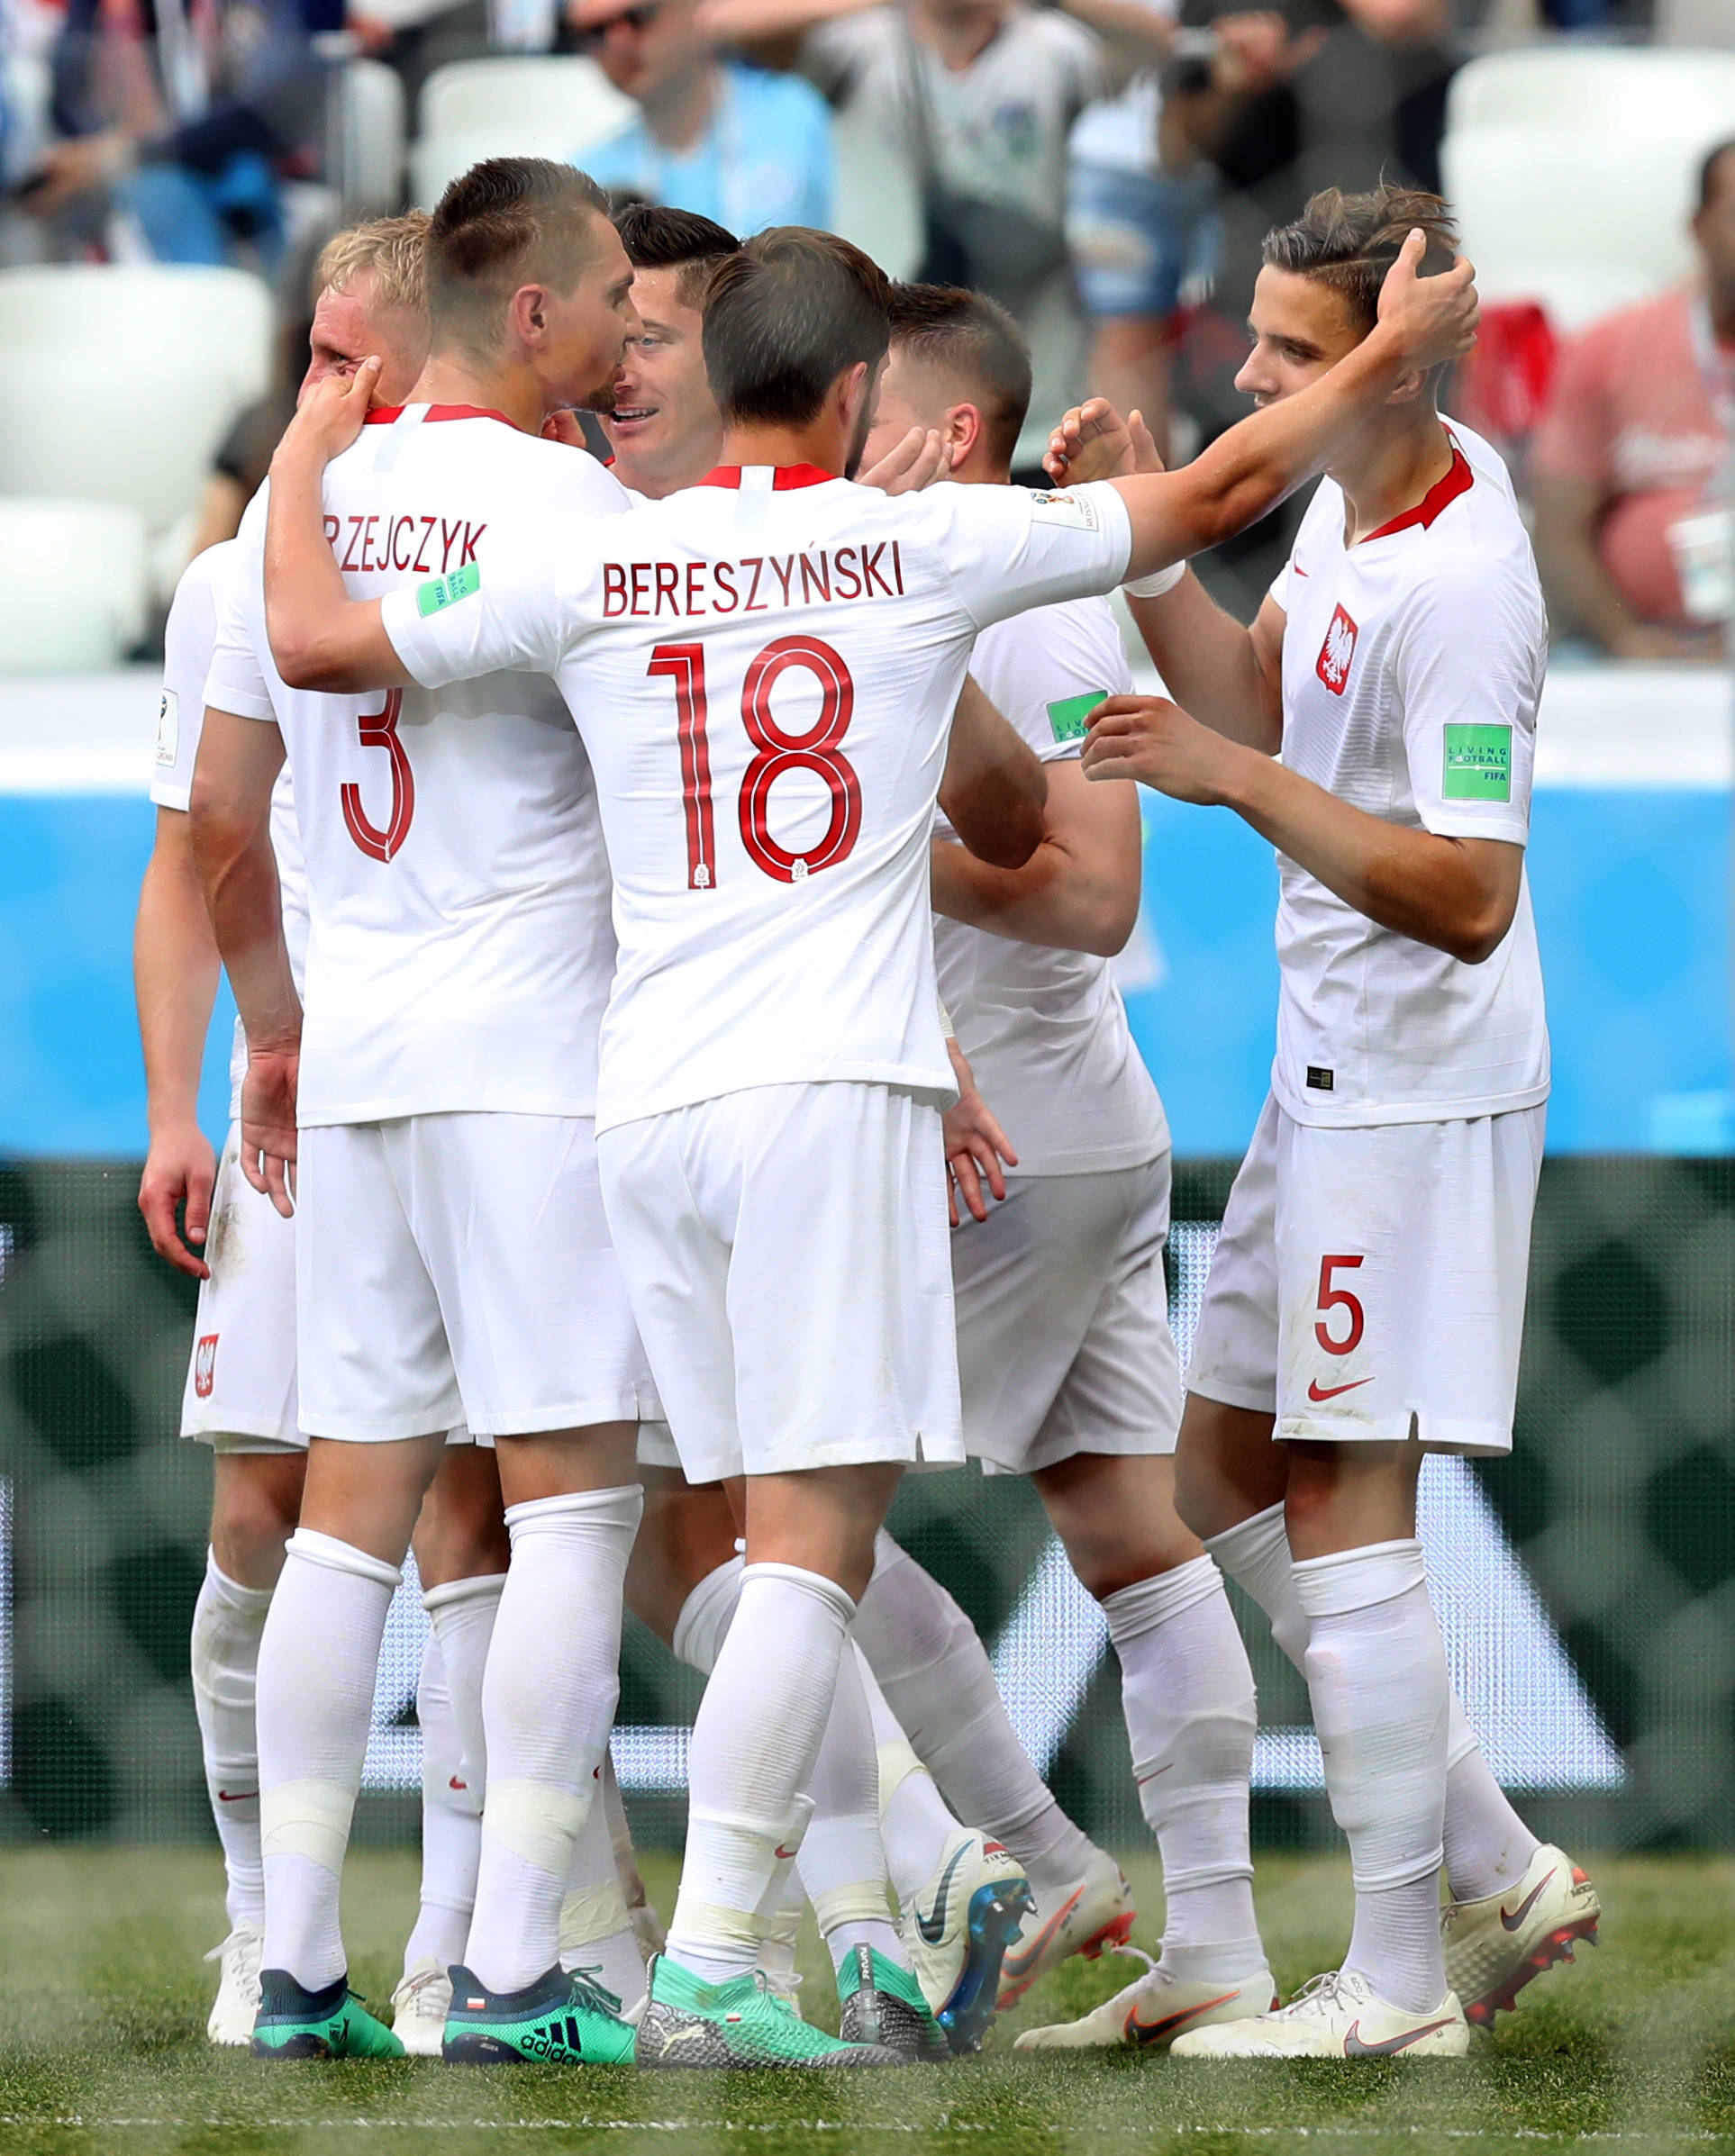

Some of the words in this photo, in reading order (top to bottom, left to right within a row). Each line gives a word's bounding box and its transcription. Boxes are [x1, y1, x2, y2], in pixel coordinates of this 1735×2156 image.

[603, 540, 904, 618] BERESZYŃSKI
[341, 687, 415, 864] 3
[647, 634, 862, 890] 18
[1449, 747, 1506, 756] LIVING
[1449, 756, 1506, 764] FOOTBALL
[1476, 772, 1506, 781] FIFA
[1315, 1255, 1365, 1355] 5
[520, 2033, 586, 2065] adida
